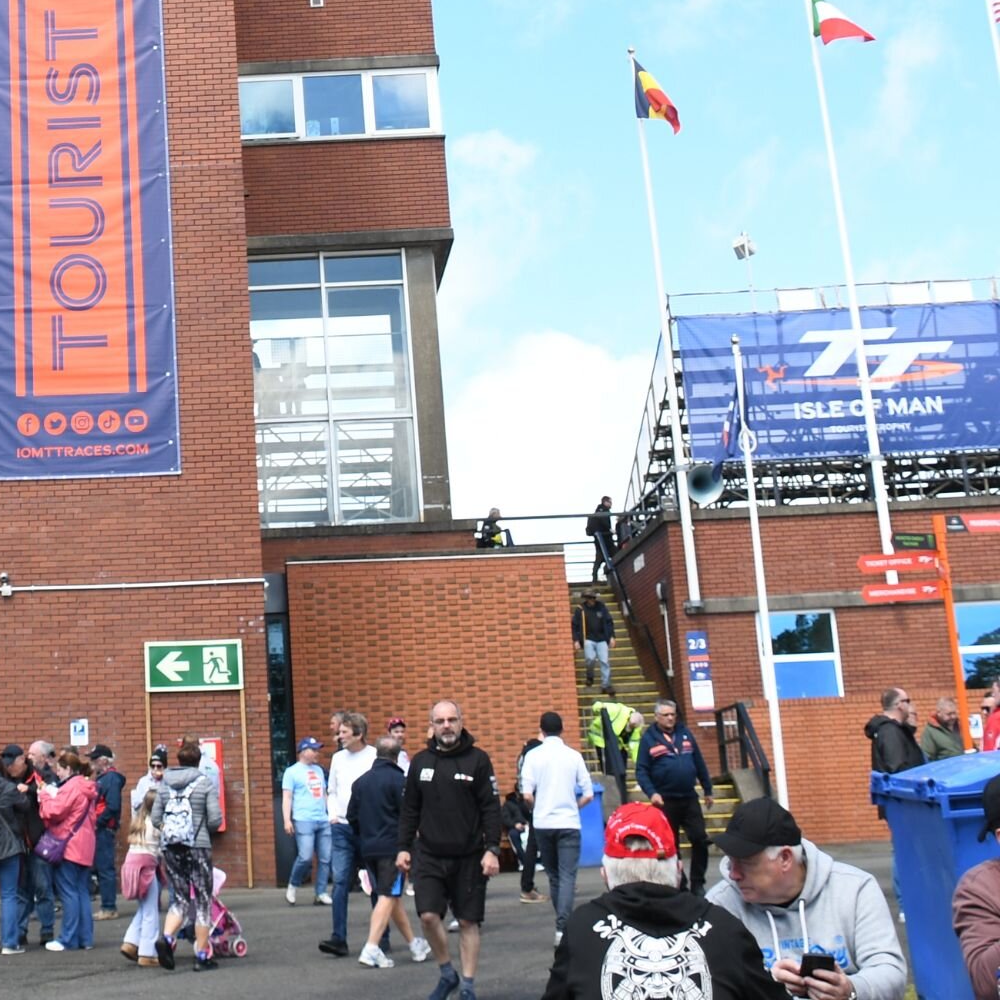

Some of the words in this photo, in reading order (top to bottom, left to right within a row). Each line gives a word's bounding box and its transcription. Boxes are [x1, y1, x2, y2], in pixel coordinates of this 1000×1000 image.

[44, 10, 109, 371] TOURIST
[799, 327, 953, 391] TT
[793, 400, 845, 420] ISLE
[887, 396, 944, 415] MAN
[16, 443, 150, 459] IOMTTRACES.COM
[688, 638, 706, 650] 2/3
